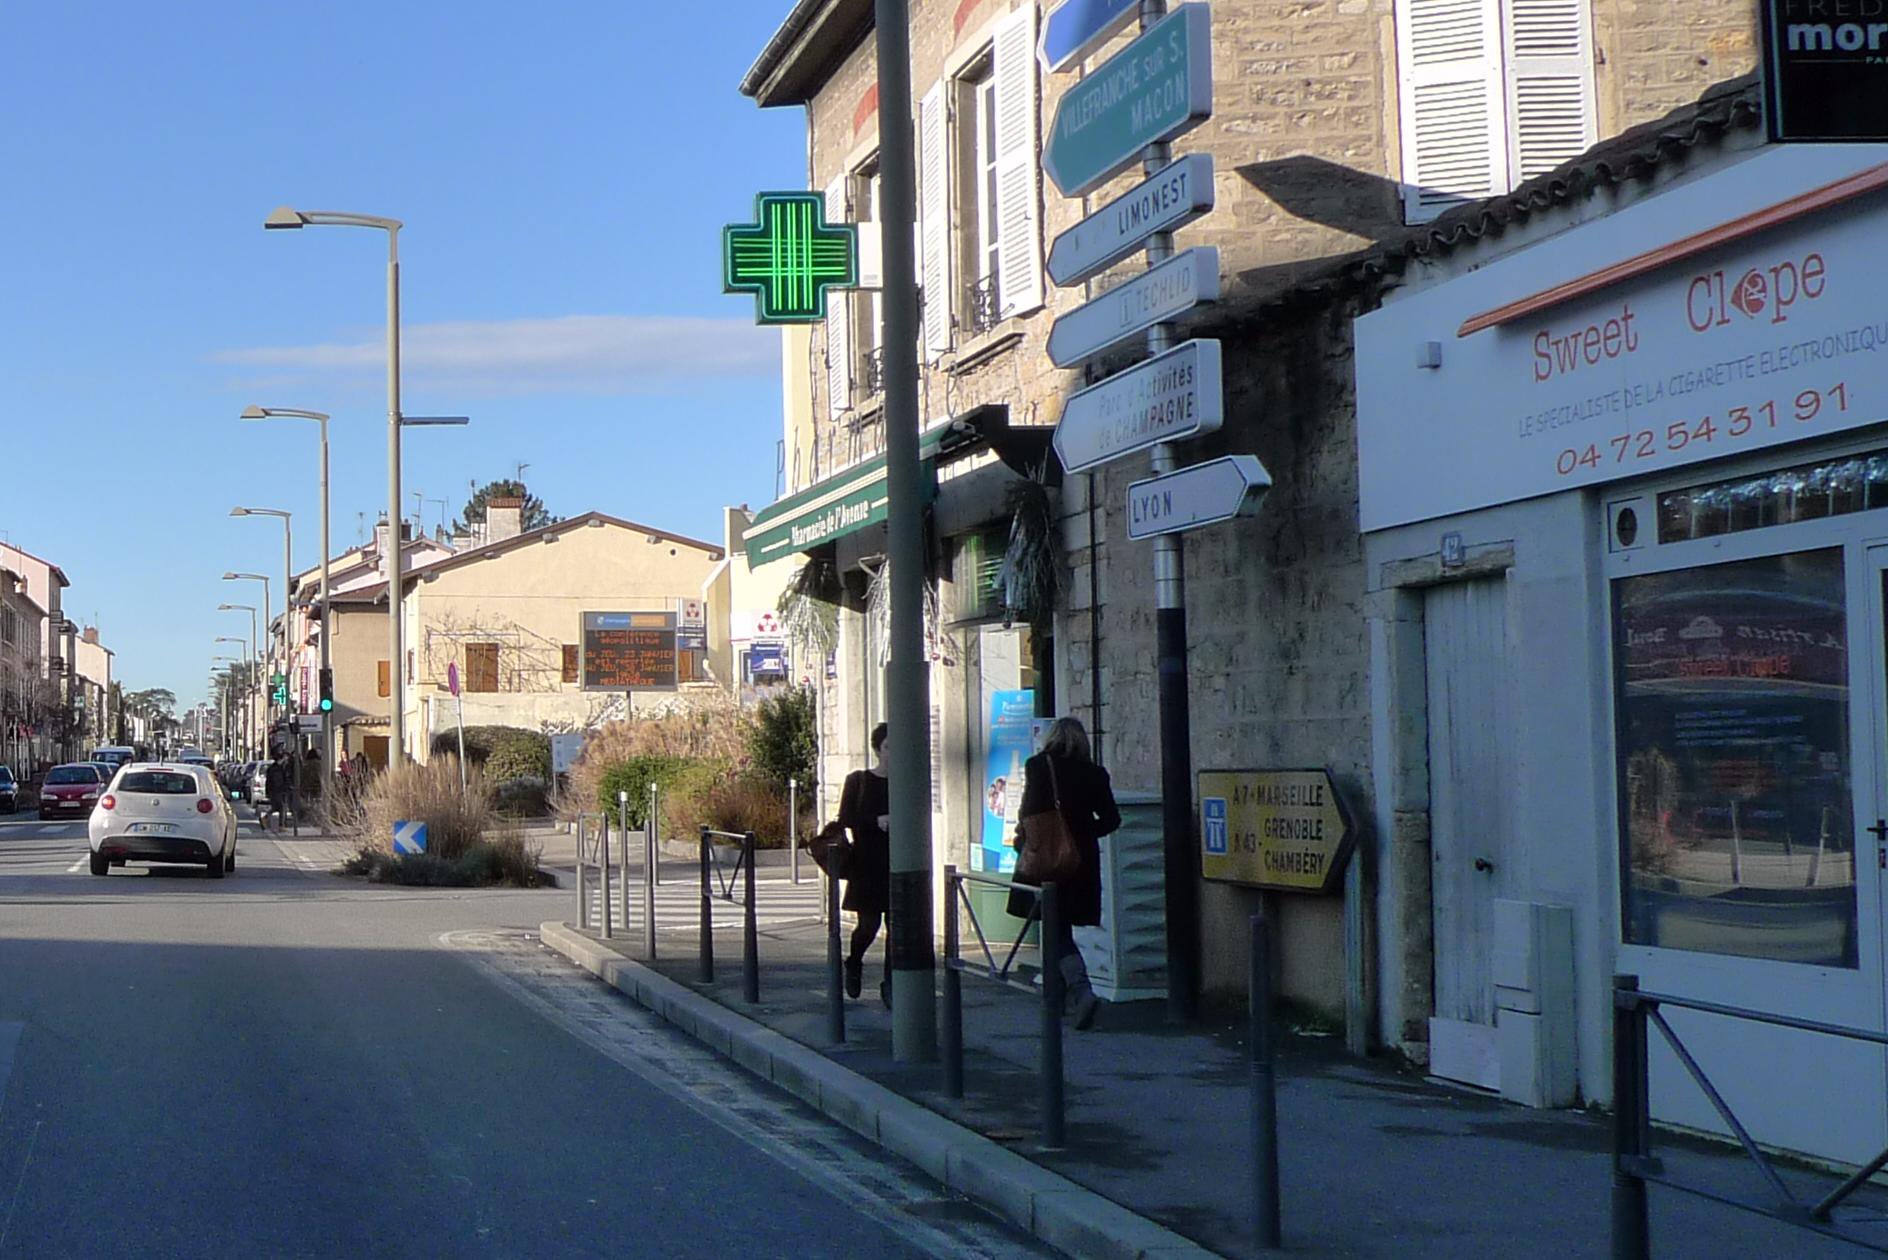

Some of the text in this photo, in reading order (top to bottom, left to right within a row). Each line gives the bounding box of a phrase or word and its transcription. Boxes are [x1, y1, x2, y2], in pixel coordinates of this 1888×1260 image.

[1061, 59, 1139, 139] VILLEFRANCHE
[1118, 173, 1187, 236] LIMONEST
[1136, 266, 1191, 314] TECHLID
[1533, 304, 1639, 383] Sweet
[1114, 391, 1193, 446] CHAMPAGNE
[1519, 415, 1532, 438] LE
[1536, 390, 1620, 432] SPECIALISTE
[1624, 384, 1643, 409] DE
[1646, 379, 1664, 404] LA
[1668, 355, 1755, 398] CIGARETTE
[1556, 382, 1849, 476] 04 72 54 31 91
[791, 515, 826, 546] Pharmacie
[827, 512, 835, 533] de
[1132, 490, 1172, 524] LYON
[1256, 784, 1324, 807] MARSEILLE
[1264, 818, 1323, 841] GRENOBLE
[1264, 847, 1325, 875] CHAMBÉRY
